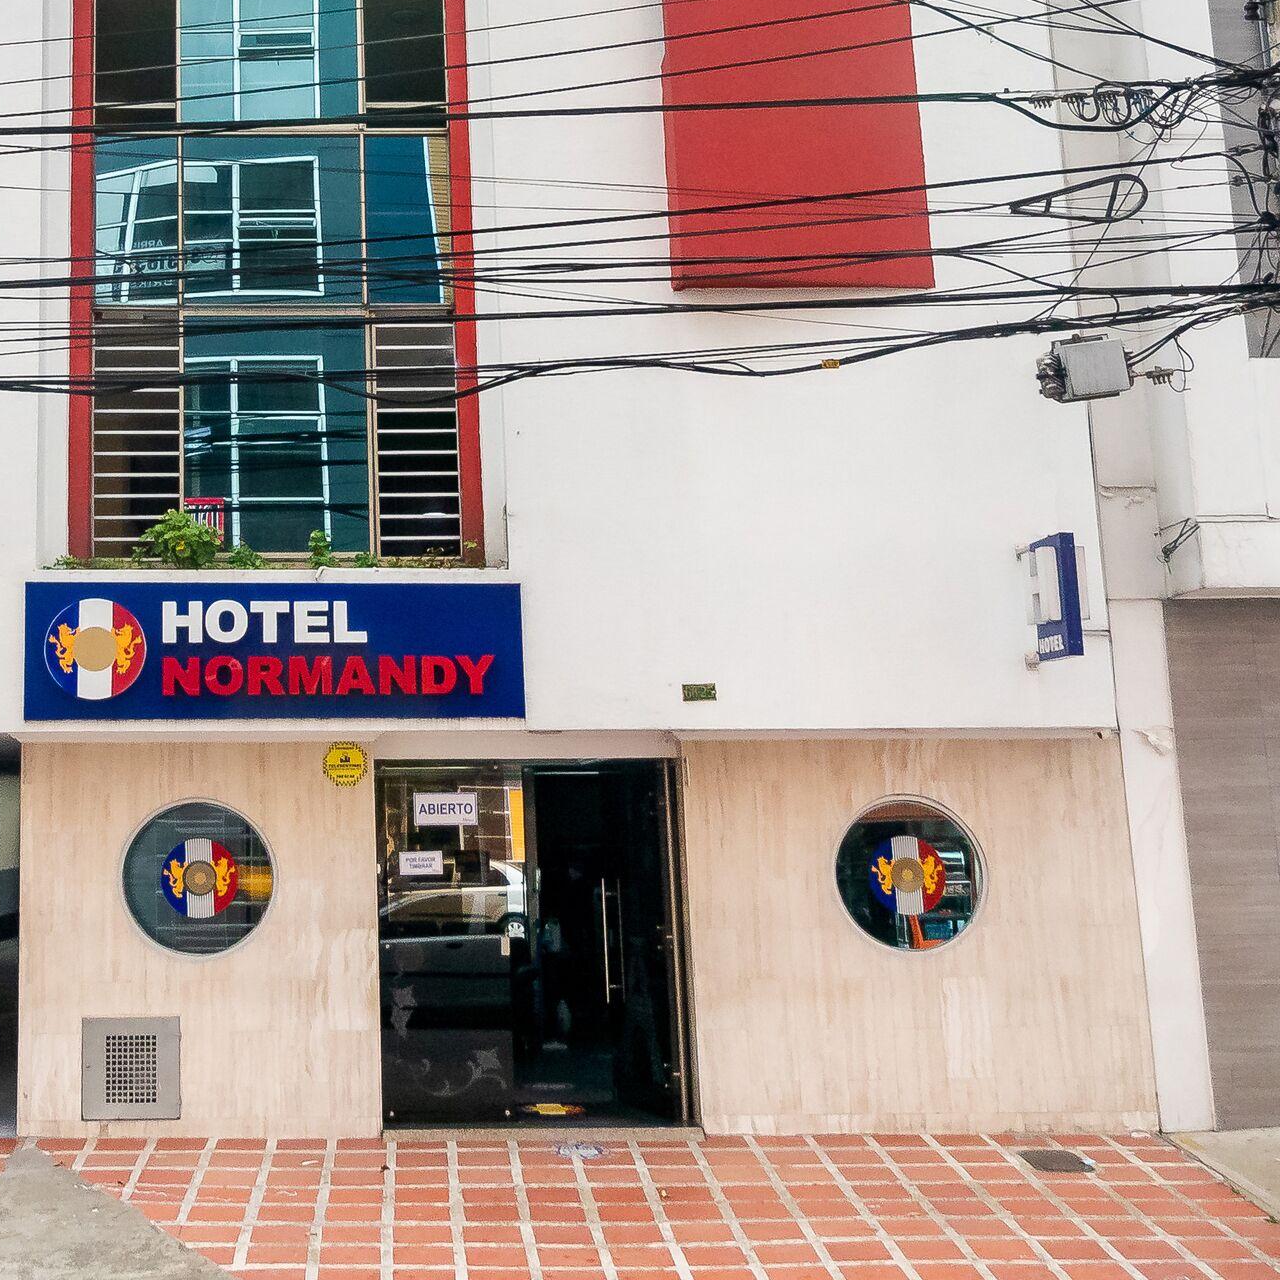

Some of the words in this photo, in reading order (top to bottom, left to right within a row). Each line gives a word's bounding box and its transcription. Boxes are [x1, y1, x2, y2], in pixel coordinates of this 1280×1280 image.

[161, 600, 368, 644] HOTEL
[161, 653, 496, 697] NORMANDY
[419, 803, 474, 815] ABIERTO
